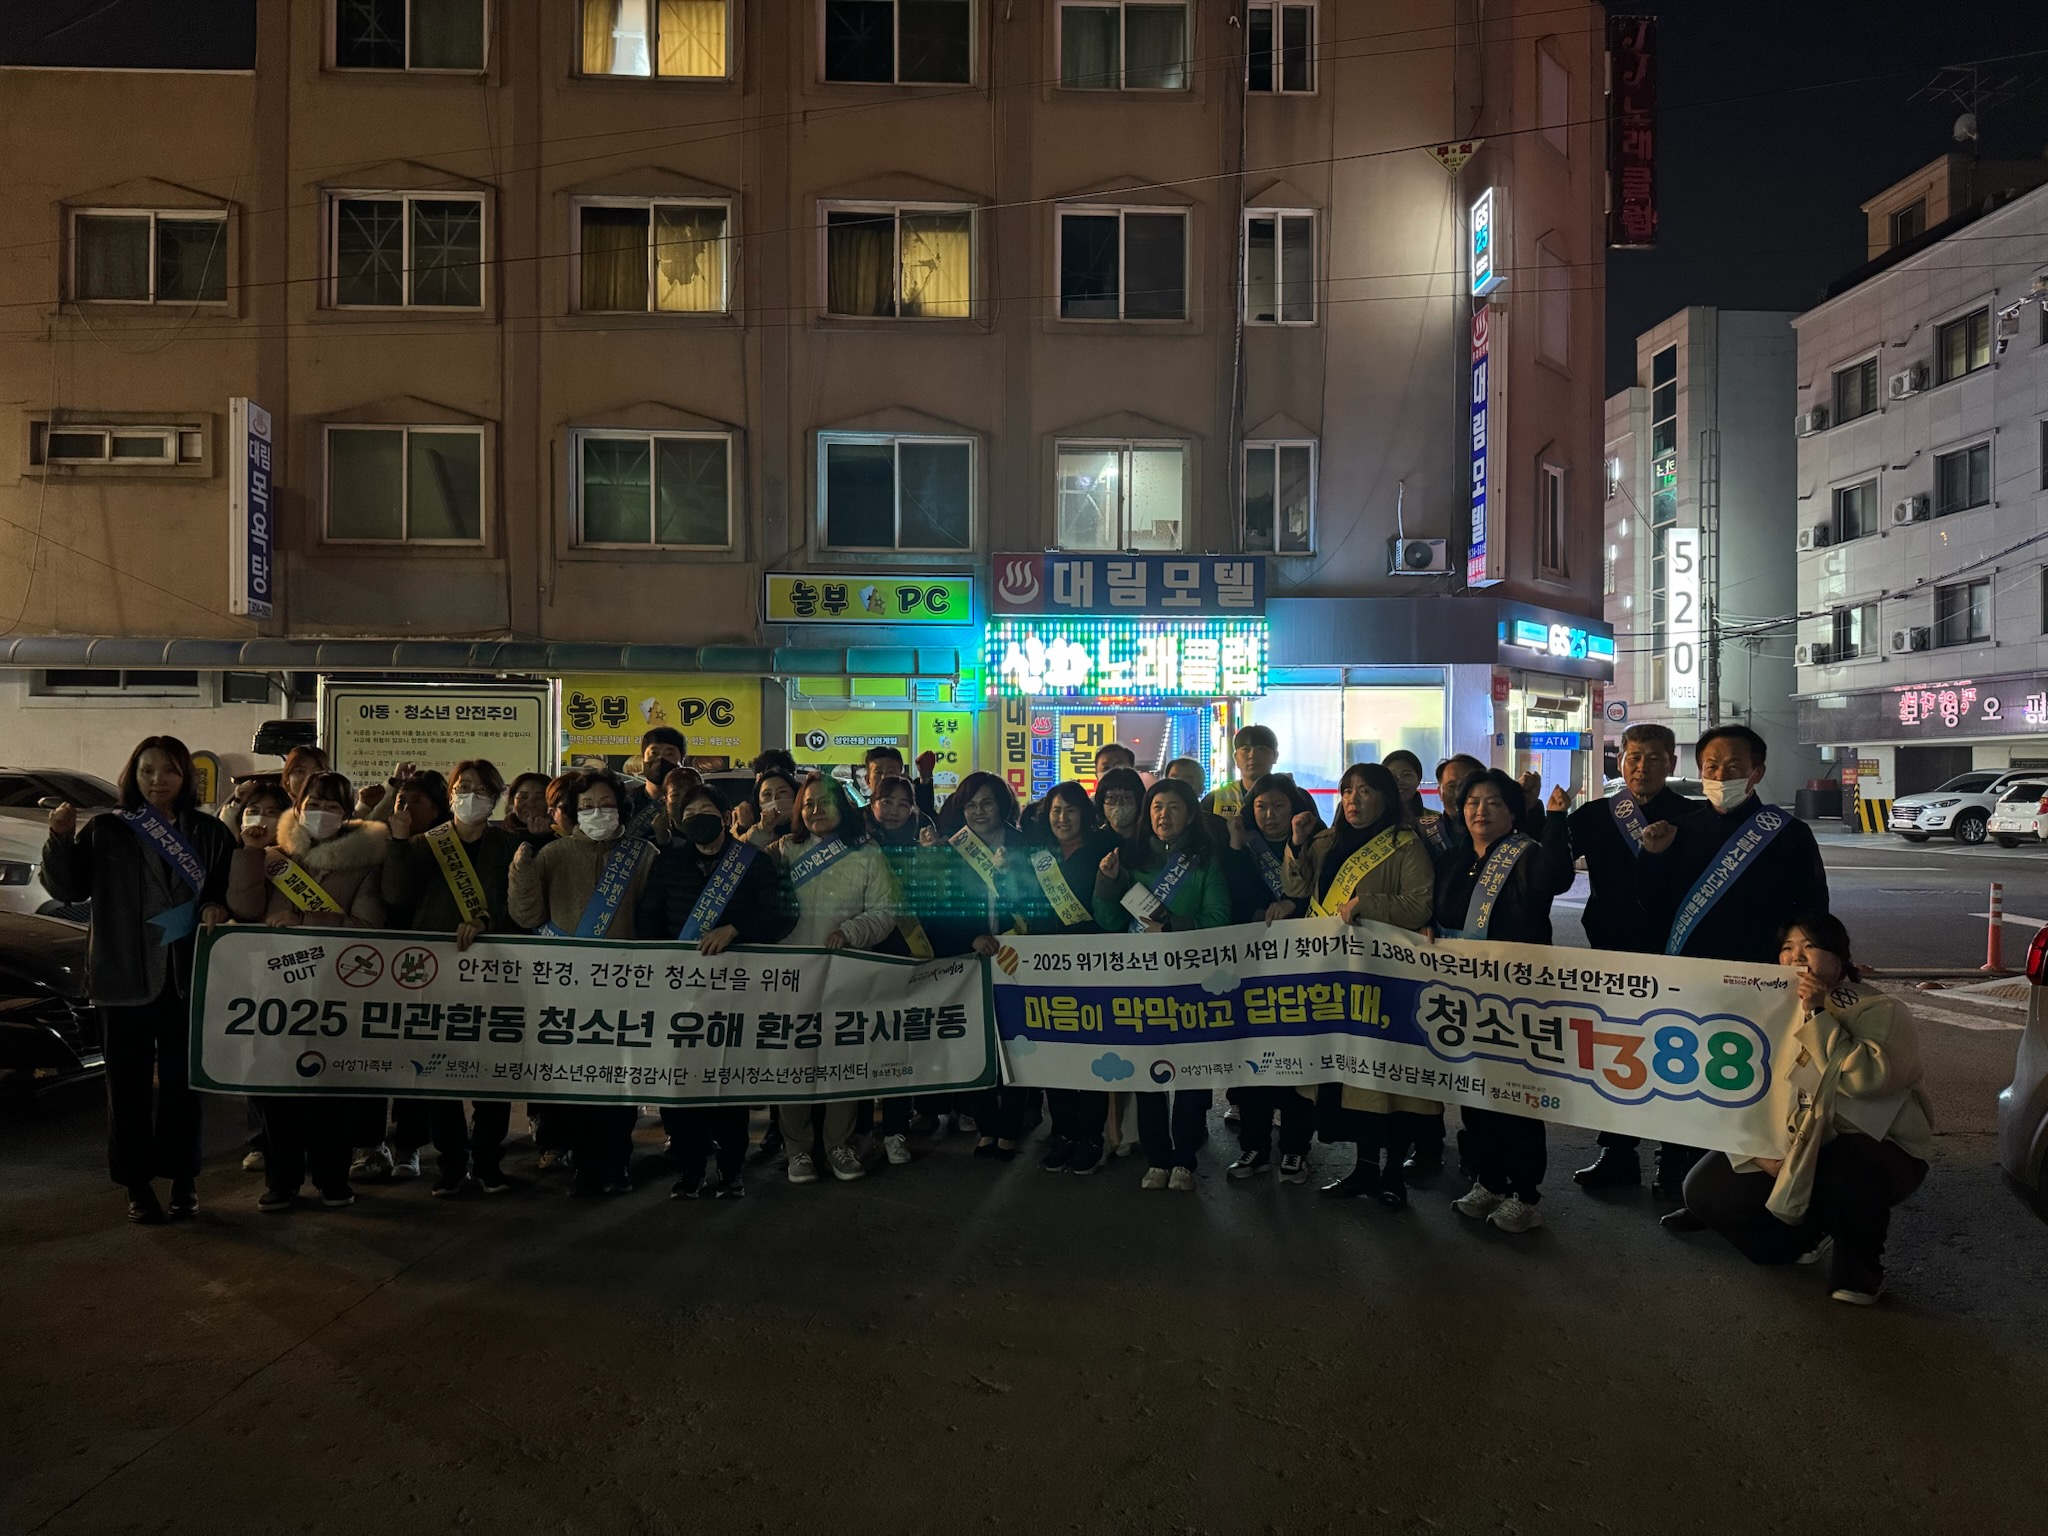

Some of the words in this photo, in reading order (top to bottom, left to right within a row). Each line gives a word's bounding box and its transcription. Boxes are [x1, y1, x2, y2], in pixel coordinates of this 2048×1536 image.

[1053, 561, 1254, 608] 대림모텔
[790, 580, 849, 616] 놀부
[896, 586, 950, 614] PC
[1549, 623, 1587, 659] GS25
[1671, 687, 1696, 698] MOTEL
[360, 705, 390, 719] 아동
[404, 705, 450, 719] 청소년
[456, 706, 517, 720] 안전주의
[567, 692, 629, 729] 놀부
[678, 697, 735, 727] PC
[932, 718, 958, 734] 놀부
[811, 735, 824, 745] 19
[1545, 737, 1569, 746] ATM
[935, 752, 958, 763] PC
[266, 946, 326, 972] 유해환경
[1033, 953, 1072, 971] 2025
[1076, 951, 1159, 972] 위기청소년
[1164, 945, 1237, 970] 아웃리치
[1244, 939, 1278, 962] 사업
[1295, 935, 1365, 959] 찾아가는
[1372, 939, 1416, 965] 1388
[283, 965, 318, 984] OUT
[458, 958, 523, 984] 안전한
[532, 959, 579, 986] 환경,
[589, 963, 654, 989] 건강한
[664, 964, 751, 991] 청소년을
[760, 967, 800, 993] 위해
[1025, 996, 1103, 1031] 마음이
[1112, 996, 1235, 1033] 막막하고
[1244, 982, 1345, 1025] 답답할
[1349, 983, 1391, 1031] 때,
[224, 997, 348, 1037] 2025
[361, 1001, 526, 1043] 민관합동
[537, 1005, 655, 1048] 청소년
[667, 1011, 745, 1049] 유해
[756, 1011, 823, 1050] 환경
[834, 1004, 968, 1046] 감시활동
[332, 1059, 393, 1073] 여성가족부
[445, 1059, 480, 1074] 보령시
[493, 1062, 689, 1086] 보령시청소년유해환경감시단
[702, 1063, 869, 1085] 보령시청소년상담복지센터
[1181, 1063, 1233, 1077] 여성가족부
[1275, 1057, 1303, 1070] 보령시
[1491, 1087, 1521, 1102] 청소년
[1524, 1092, 1560, 1109] 1388
